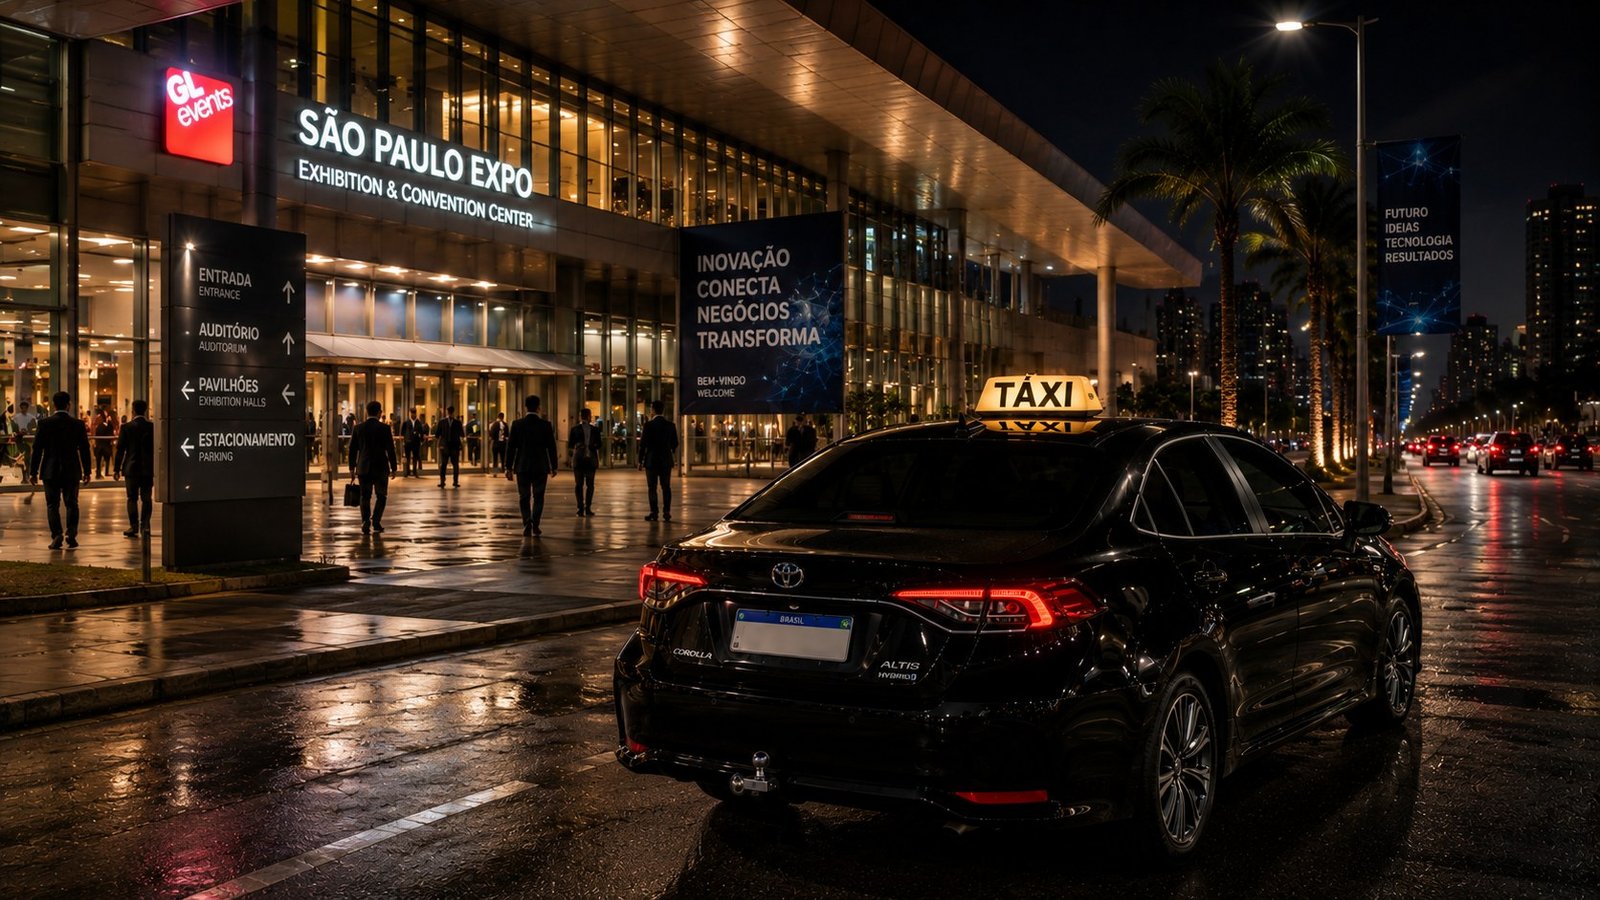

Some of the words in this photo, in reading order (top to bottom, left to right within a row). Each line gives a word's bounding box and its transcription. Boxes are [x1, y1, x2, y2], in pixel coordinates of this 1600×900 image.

[166, 70, 205, 105] GL
[177, 87, 234, 128] events
[299, 107, 366, 157] SÃO
[375, 128, 464, 181] PAULO
[470, 154, 533, 199] EXPO
[298, 158, 383, 197] EXHIBITION
[386, 180, 398, 199] &
[401, 183, 486, 219] CONVENTION
[488, 203, 533, 229] CENTER
[1385, 207, 1428, 218] FUTURO
[1385, 222, 1420, 234] IDEIAS
[1385, 235, 1452, 248] TECNOLOGIA
[697, 245, 790, 272] INOVAÇÃO
[1385, 250, 1453, 262] RESULTADOS
[199, 267, 252, 288] ENTRADA
[199, 286, 241, 300] ENTRANCE
[697, 276, 780, 298] CONECTA
[697, 299, 789, 322] NEGÓCIOS
[199, 322, 260, 340] AUDITÓRIO
[697, 327, 821, 349] TRANSFORMA
[199, 341, 247, 354] AUDITORIUM
[697, 388, 736, 398] WELCOME
[994, 376, 1073, 408] TÁXI
[199, 396, 241, 407] EXHIBITION
[243, 397, 266, 408] HALLS
[199, 433, 296, 447] ESTACIONAMENTO
[199, 451, 234, 462] PARKING
[779, 615, 805, 625] BRASIL
[673, 648, 713, 660] COROLLA
[880, 660, 920, 670] ALTIS
